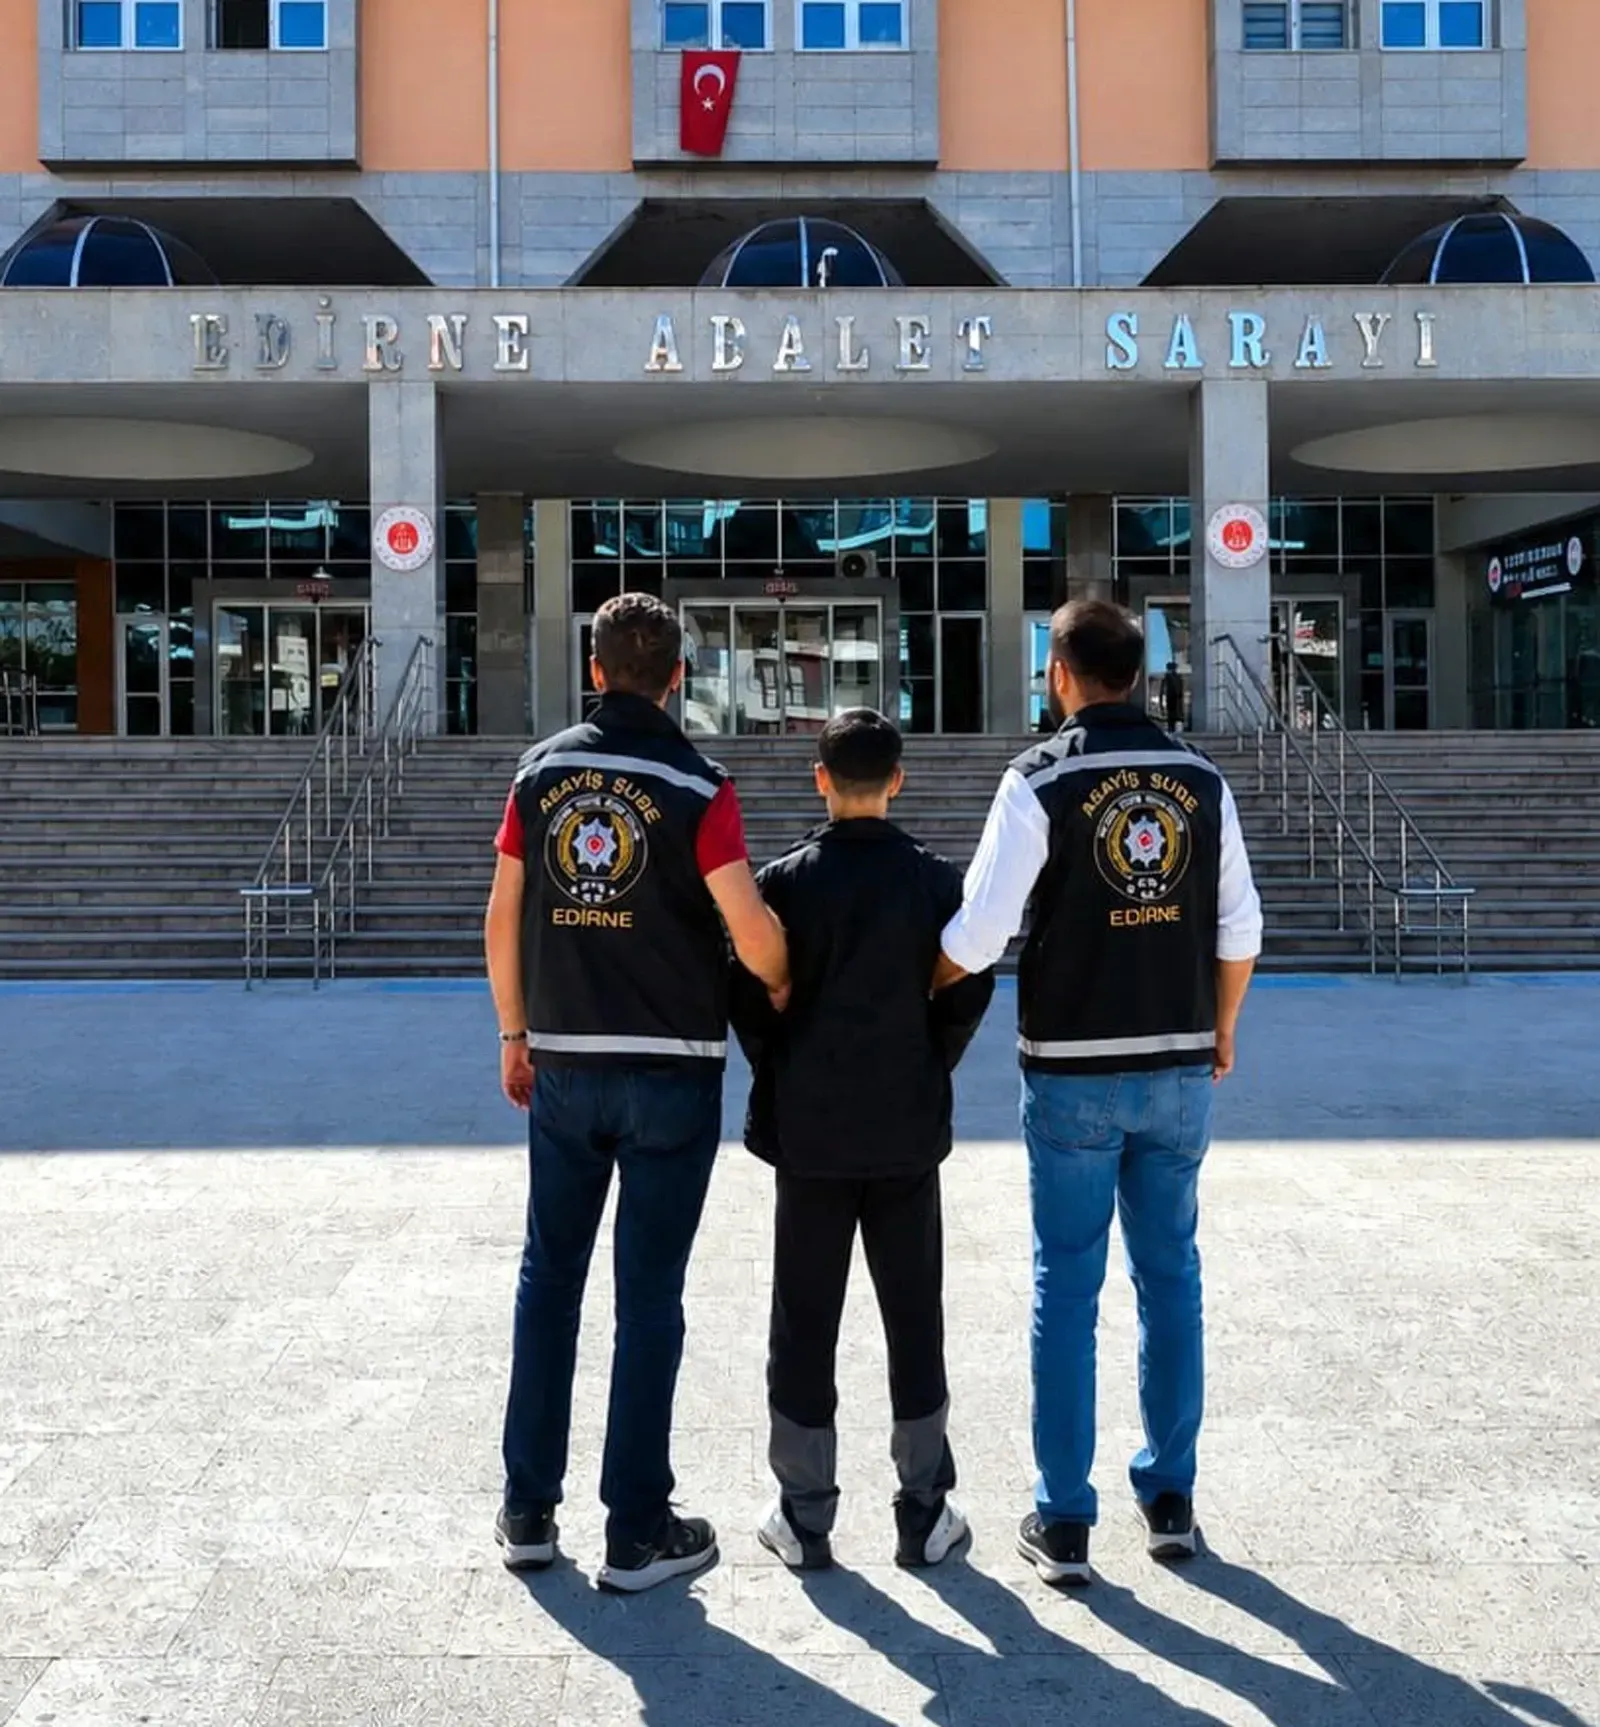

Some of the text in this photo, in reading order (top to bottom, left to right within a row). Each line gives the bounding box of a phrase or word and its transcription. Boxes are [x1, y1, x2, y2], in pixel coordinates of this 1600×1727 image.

[190, 296, 1438, 372] EDİRNE ADALET SARAYI
